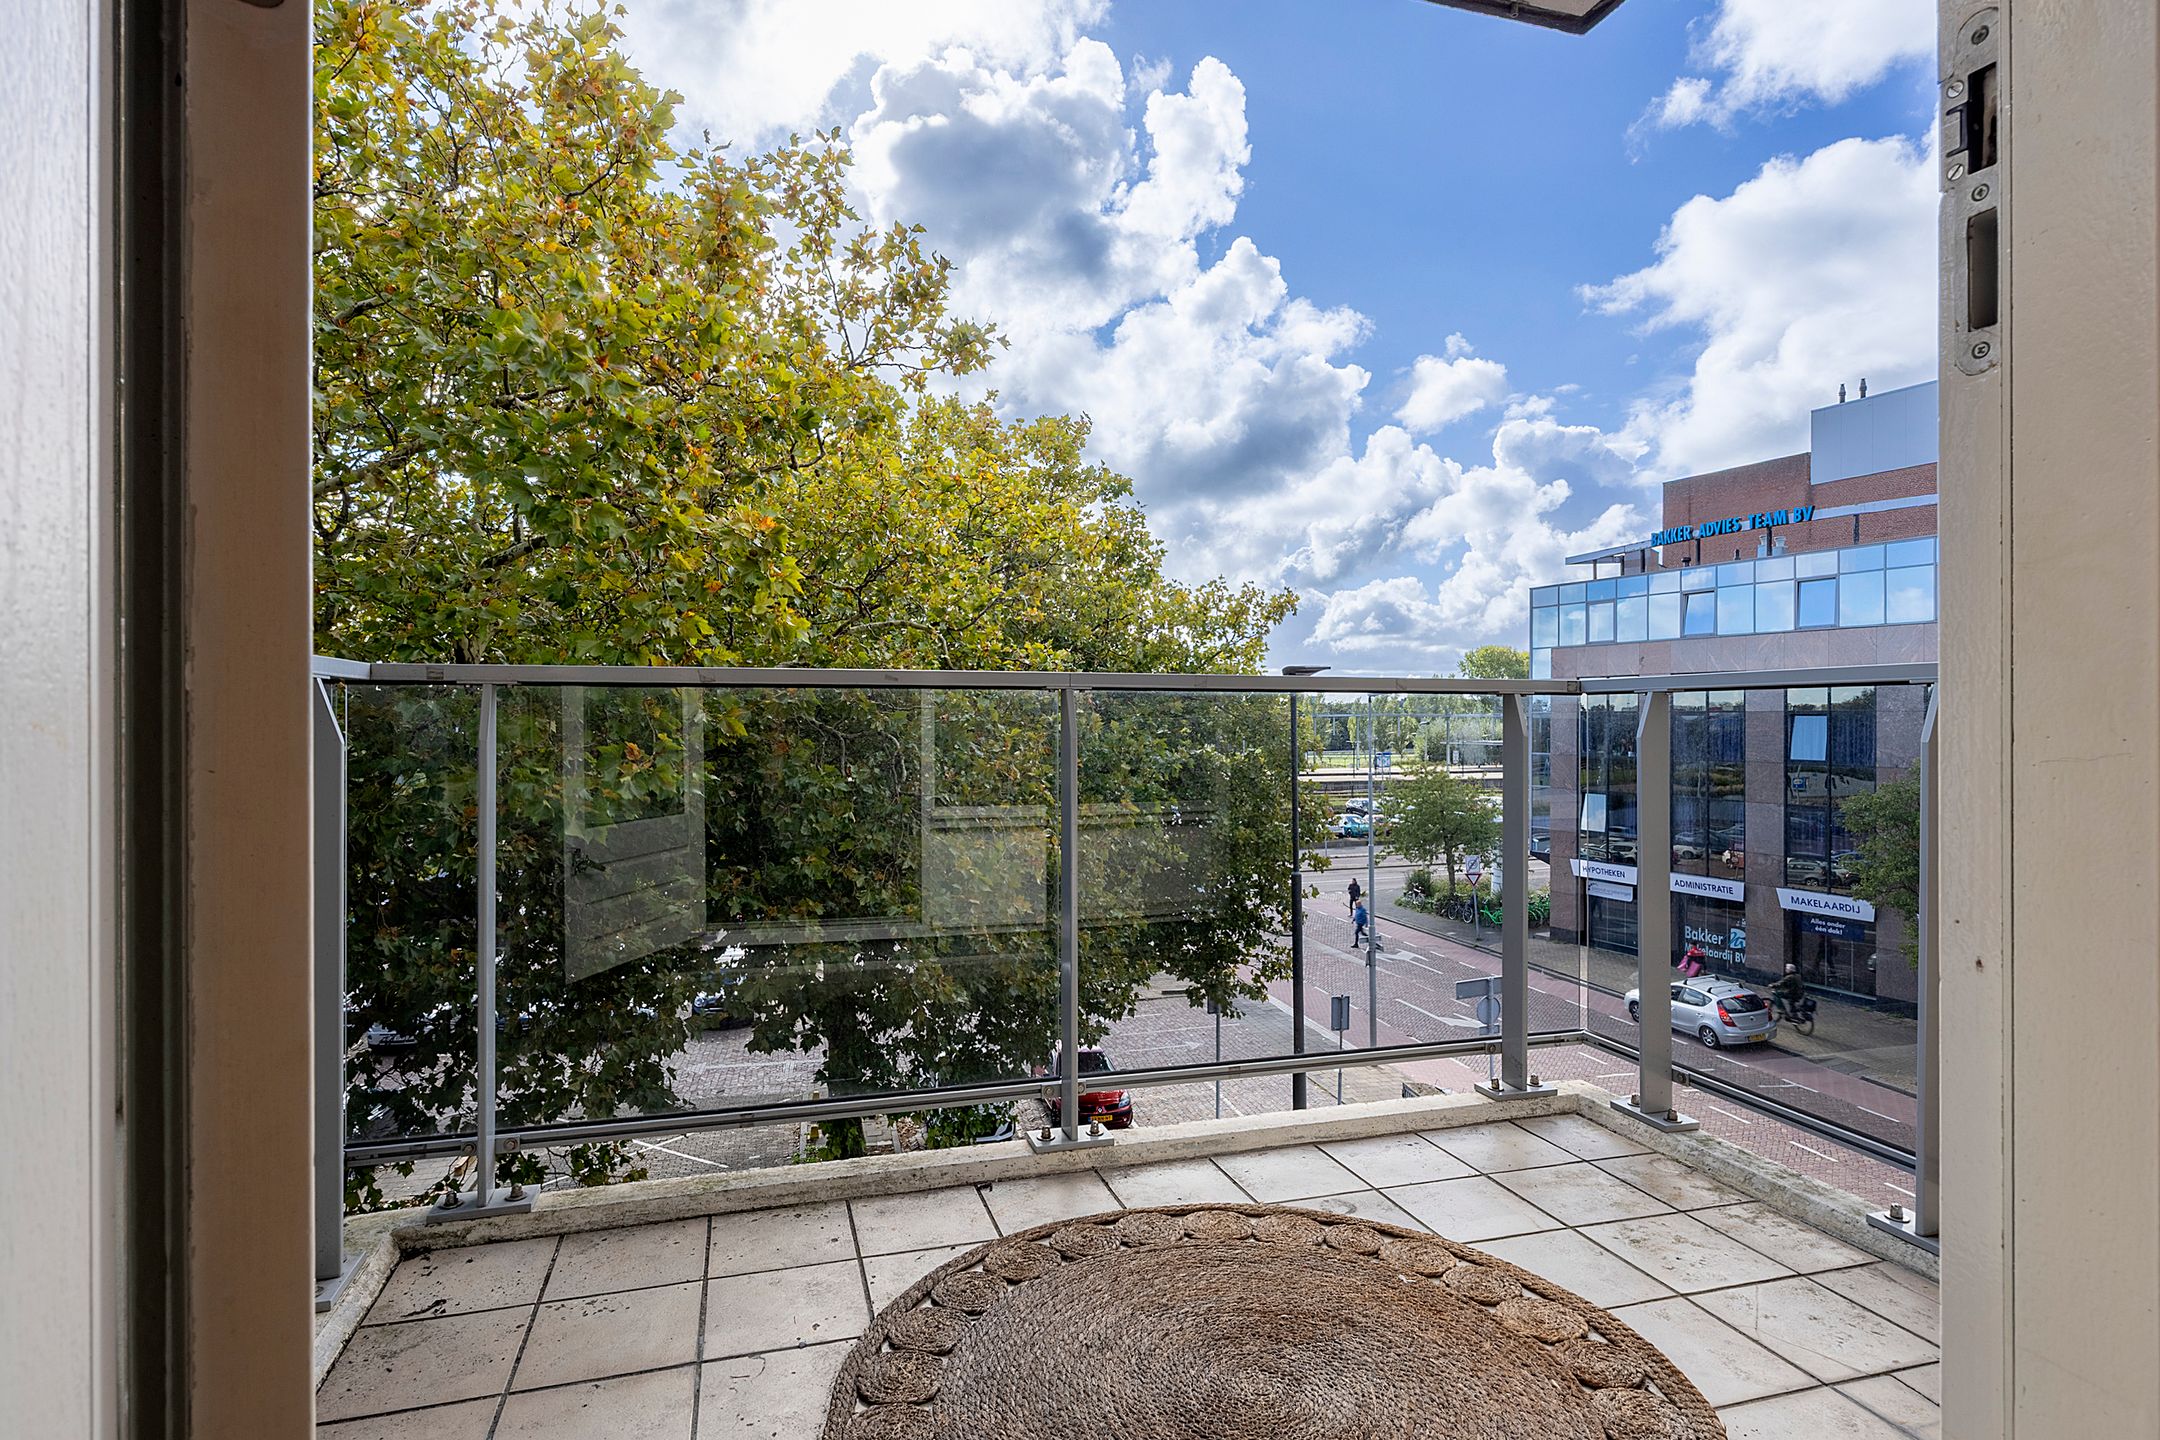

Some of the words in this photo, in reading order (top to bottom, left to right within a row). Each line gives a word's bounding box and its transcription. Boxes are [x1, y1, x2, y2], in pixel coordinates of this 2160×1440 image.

[1651, 527, 1692, 547] BAKKER
[1699, 517, 1742, 538] ADVIES
[1748, 509, 1788, 529] TEAM
[1793, 505, 1815, 523] BV
[1582, 865, 1626, 879] HYPOTHEKEN
[1674, 879, 1734, 895] ADMINISTRATIE
[1791, 896, 1860, 914] MAKELAARDIJ
[1827, 921, 1846, 929] onder
[1684, 925, 1724, 945] Bakker
[1735, 951, 1746, 964] BV
